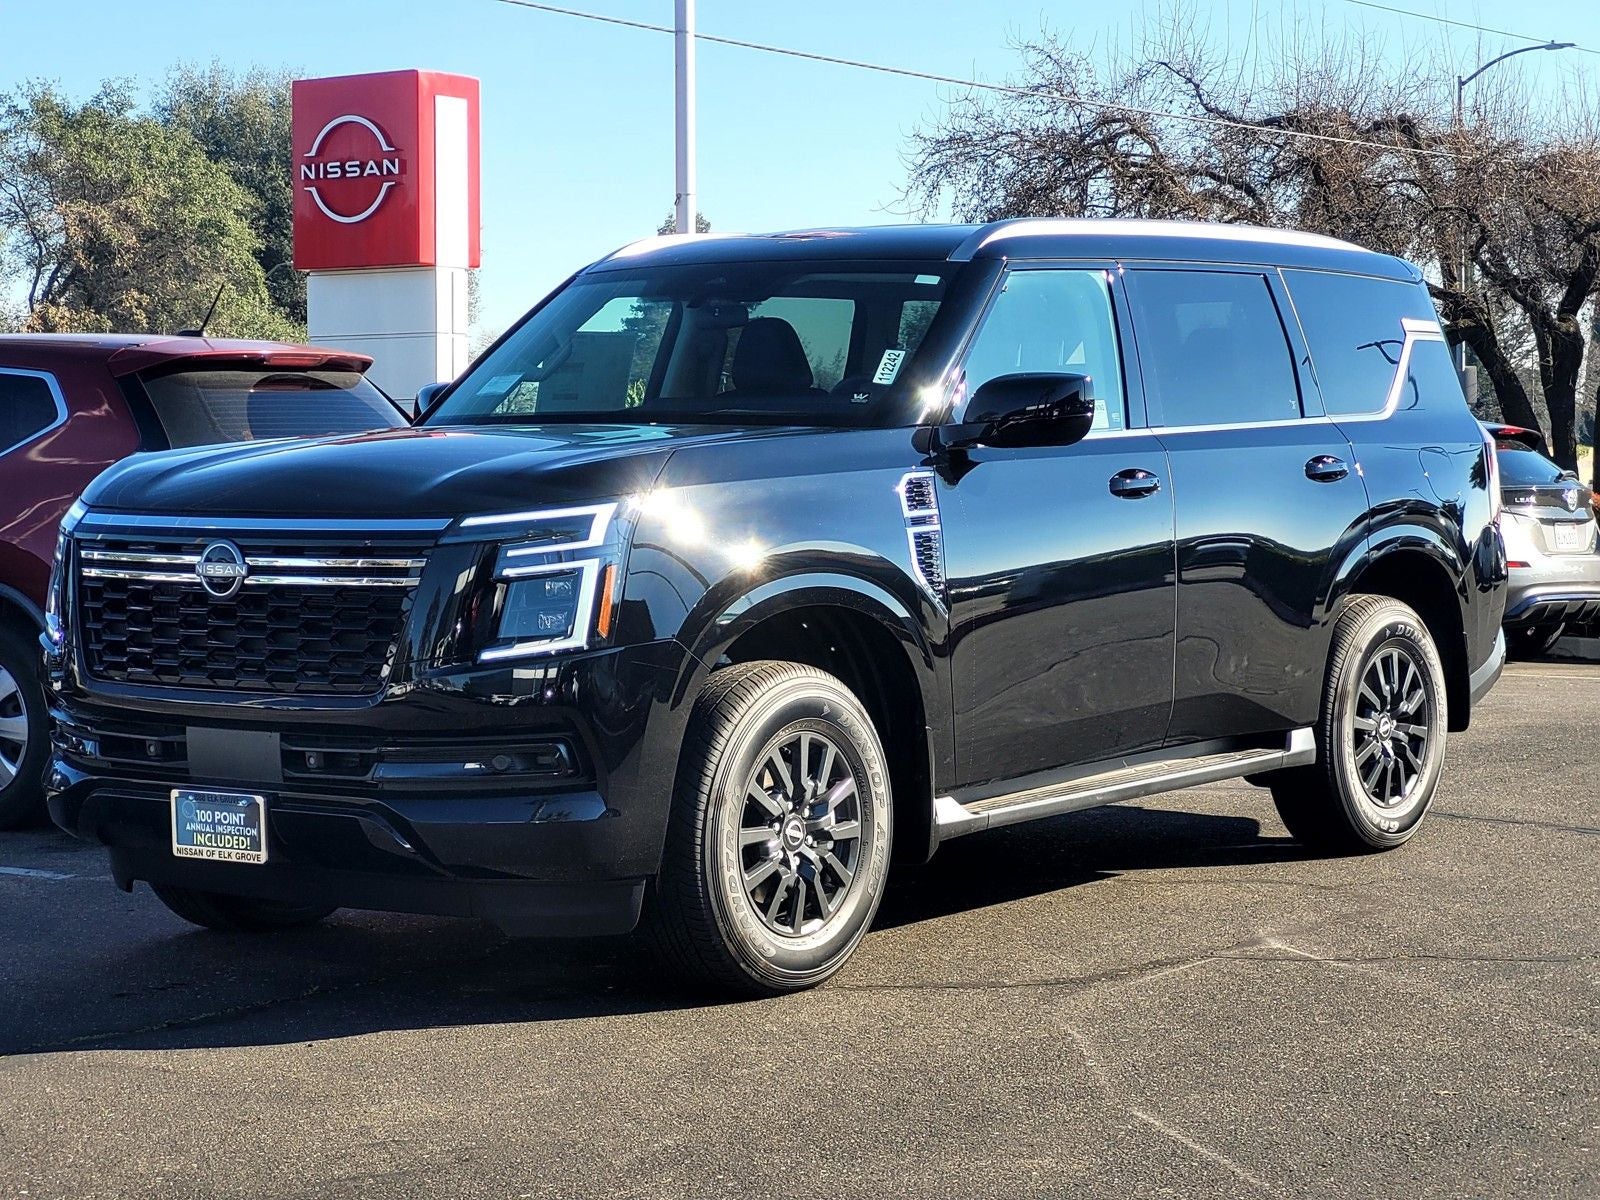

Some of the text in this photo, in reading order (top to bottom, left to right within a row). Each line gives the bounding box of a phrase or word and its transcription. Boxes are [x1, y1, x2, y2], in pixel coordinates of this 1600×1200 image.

[300, 158, 399, 181] NISSAN
[877, 352, 901, 382] 112242
[195, 564, 246, 575] NISSAN
[837, 711, 885, 809] DUNLOP
[196, 809, 246, 826] 100 POINT
[185, 822, 257, 837] ANNUAL INSPECTION
[193, 832, 251, 850] INCLUDED!
[176, 847, 262, 862] NISSAN OF ELK GROVE
